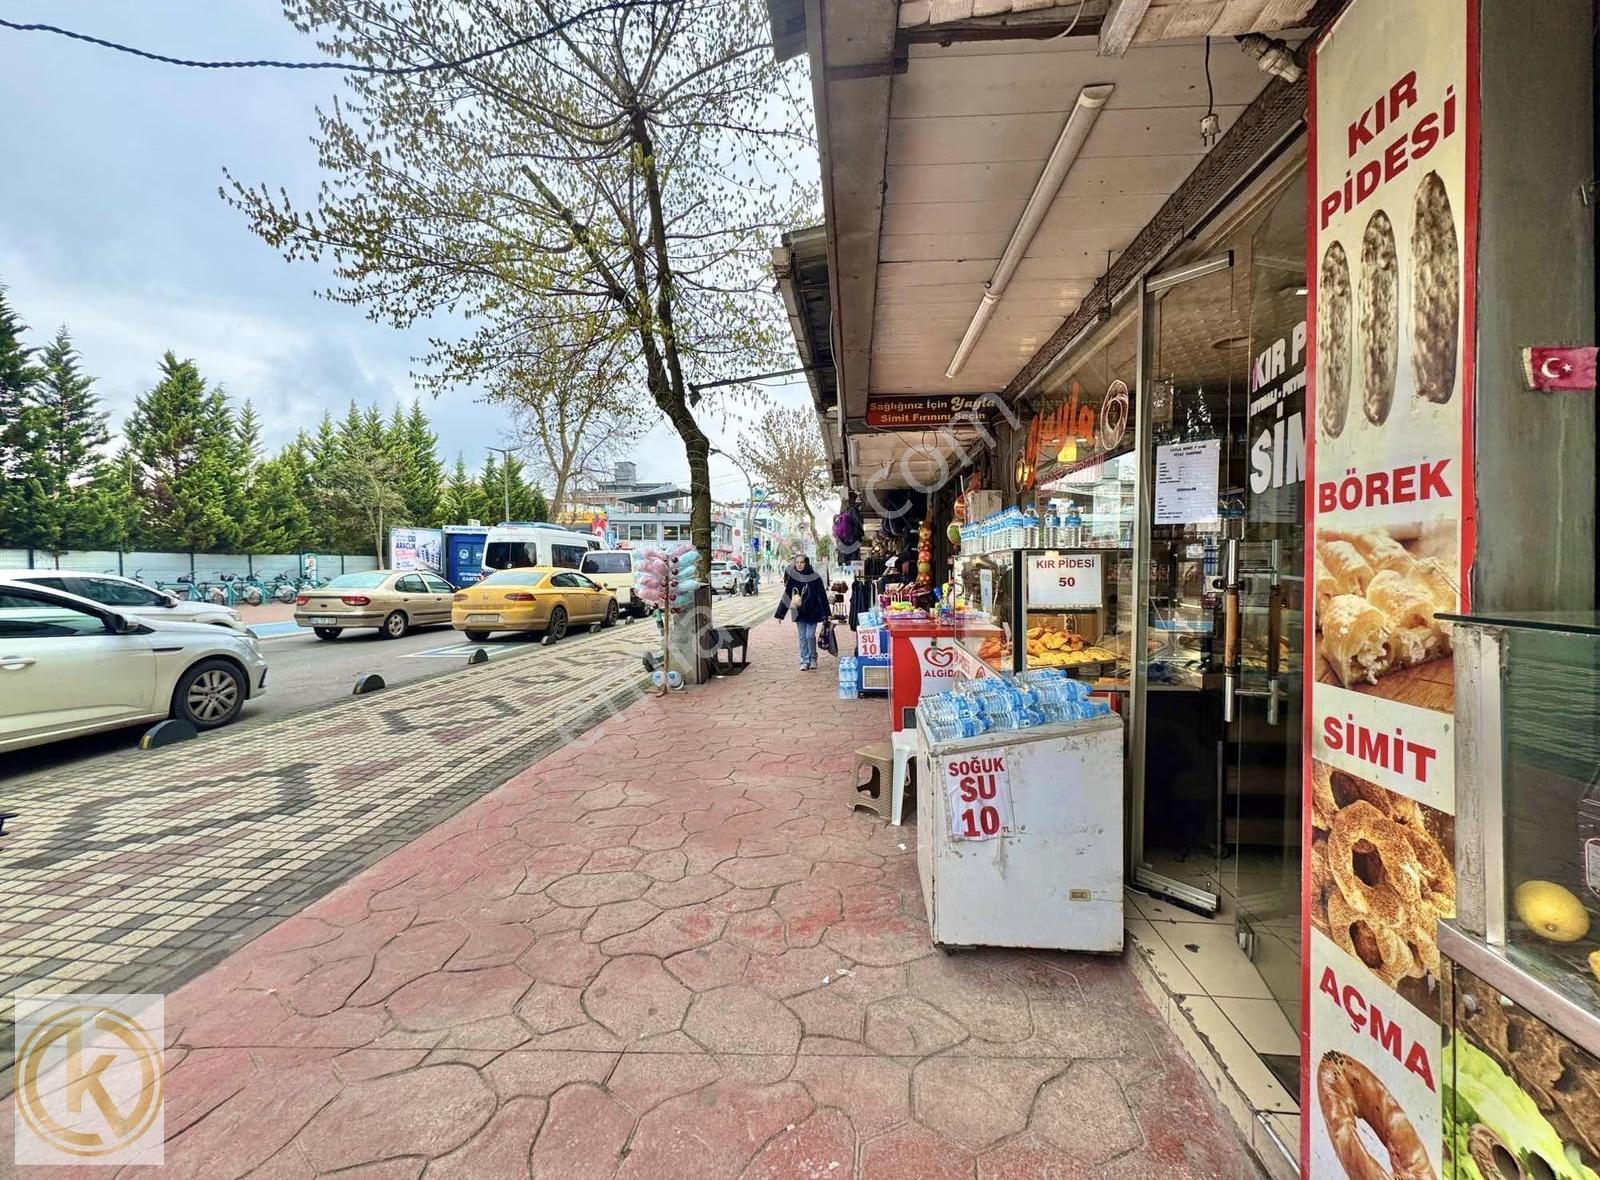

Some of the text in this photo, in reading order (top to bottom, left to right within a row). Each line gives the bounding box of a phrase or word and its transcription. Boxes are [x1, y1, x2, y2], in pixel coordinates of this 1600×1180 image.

[1348, 70, 1418, 159] KIR
[1321, 84, 1456, 232] PİDESİ
[1252, 338, 1286, 393] KIR
[870, 396, 996, 412] Sağlığınız İçin Yayla
[880, 411, 986, 423] Simit Fırınını Seçin
[1319, 458, 1453, 514] BÖREK
[1036, 556, 1095, 569] KIR PİDESİ
[1058, 576, 1076, 587] 50
[861, 634, 875, 644] SU
[862, 643, 877, 656] 10
[924, 669, 954, 678] ALGiD
[1323, 713, 1437, 783] SİMİT
[948, 756, 1006, 777] SOĞUK
[959, 774, 997, 803] SU
[961, 805, 1001, 838] 10
[1319, 965, 1437, 1094] AÇMA
